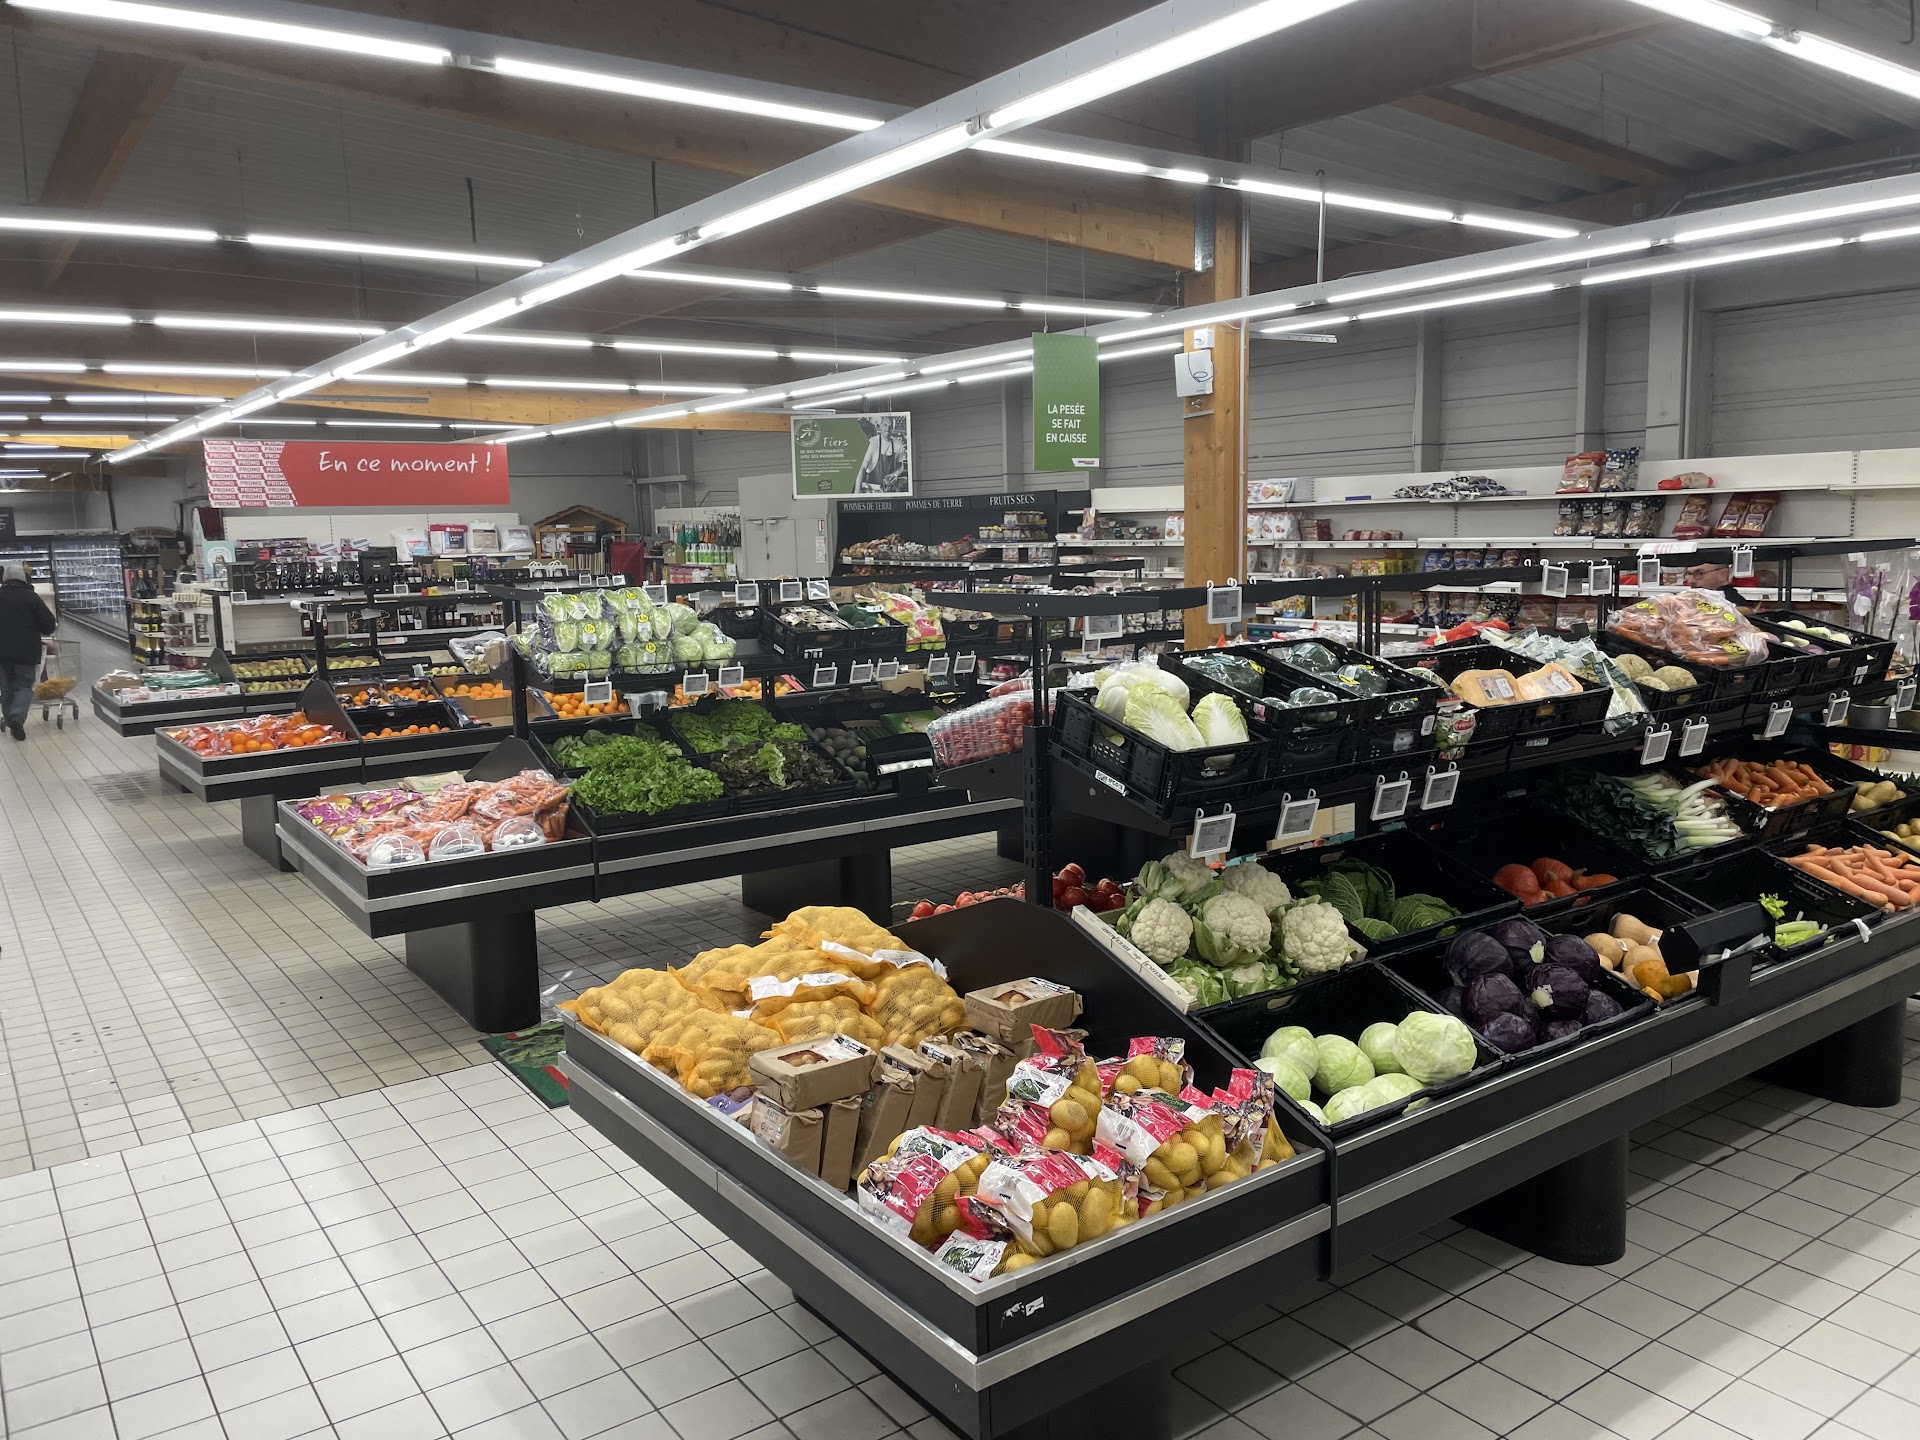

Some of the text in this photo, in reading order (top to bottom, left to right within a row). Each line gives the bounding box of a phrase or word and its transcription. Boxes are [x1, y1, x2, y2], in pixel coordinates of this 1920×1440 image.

[1047, 402, 1085, 414] LA PESÉE
[1052, 419, 1081, 428] SE FAIT
[823, 437, 848, 447] Fiers
[1046, 433, 1087, 443] EN CAISSE
[319, 451, 491, 473] En ce moment !
[905, 499, 963, 509] POMMES DE TERRE
[990, 495, 1035, 505] FRUITS SECS
[844, 502, 866, 511] POMMES
[873, 502, 892, 510] TERRE
